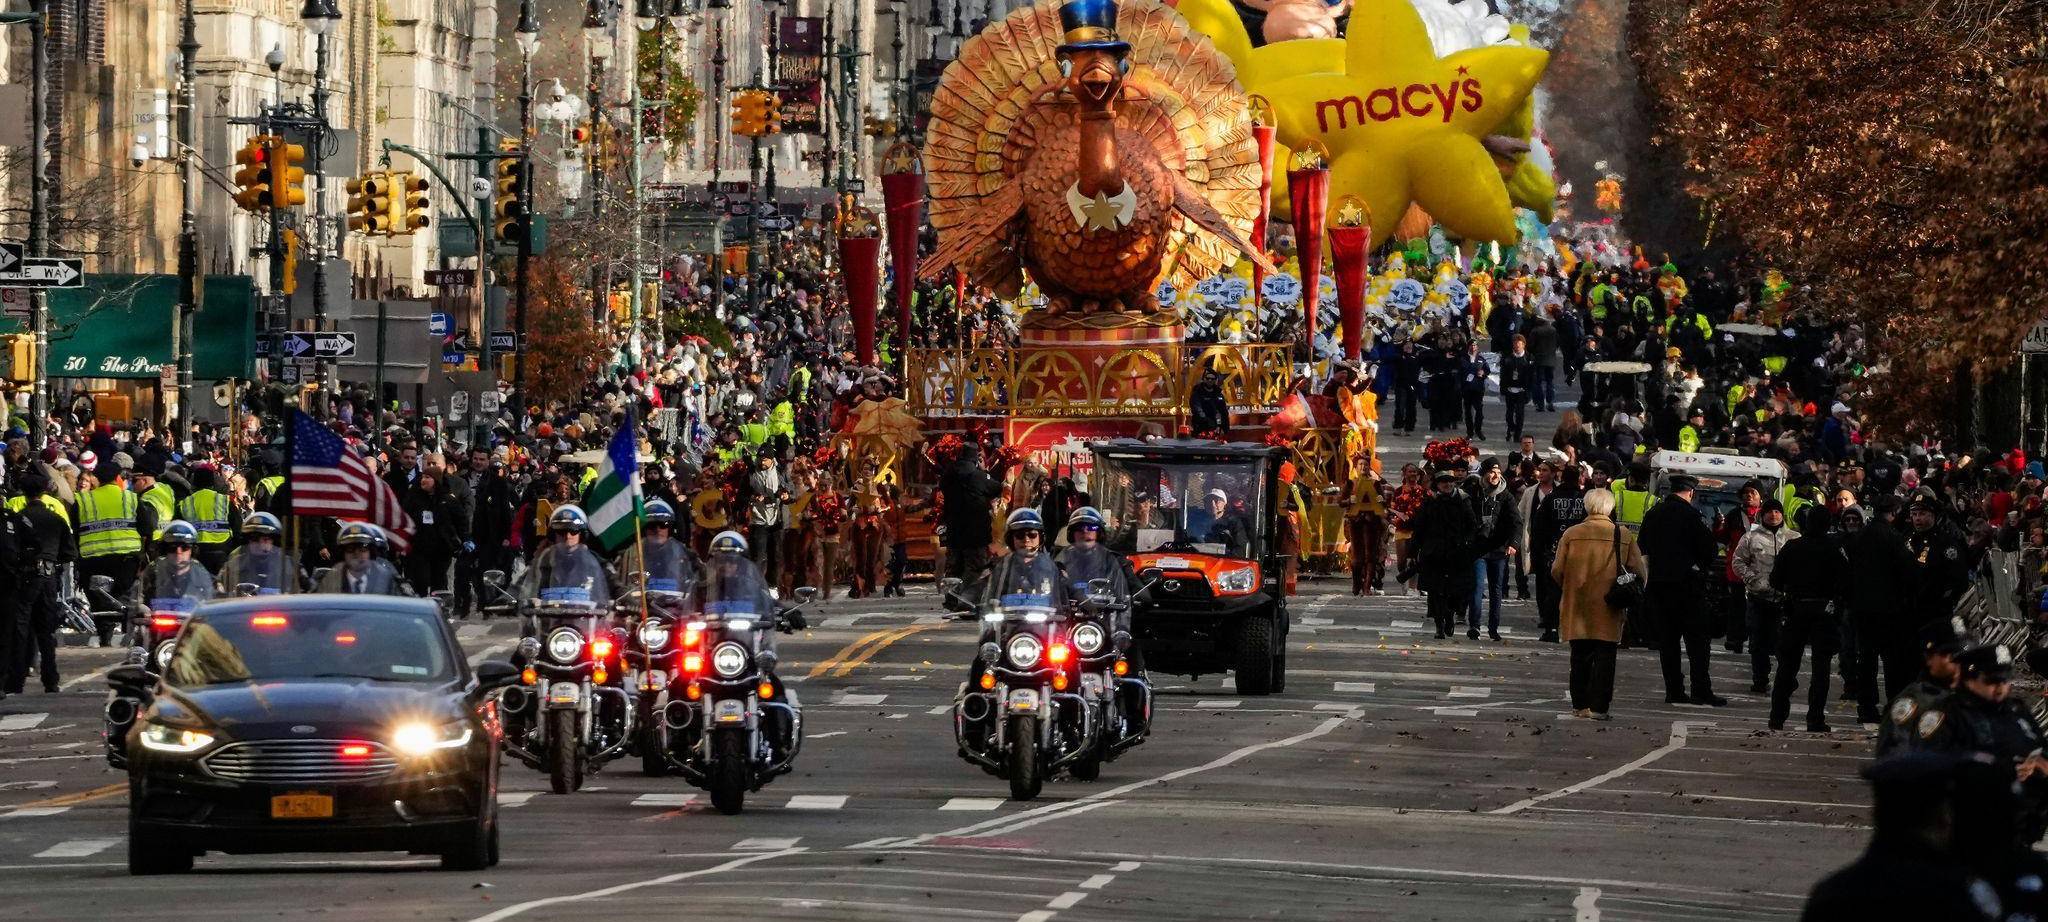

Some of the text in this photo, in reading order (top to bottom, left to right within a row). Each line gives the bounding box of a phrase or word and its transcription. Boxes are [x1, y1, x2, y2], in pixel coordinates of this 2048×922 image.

[44, 267, 70, 278] WAY
[323, 340, 346, 350] WAY
[63, 356, 87, 371] 50
[100, 356, 129, 373] The
